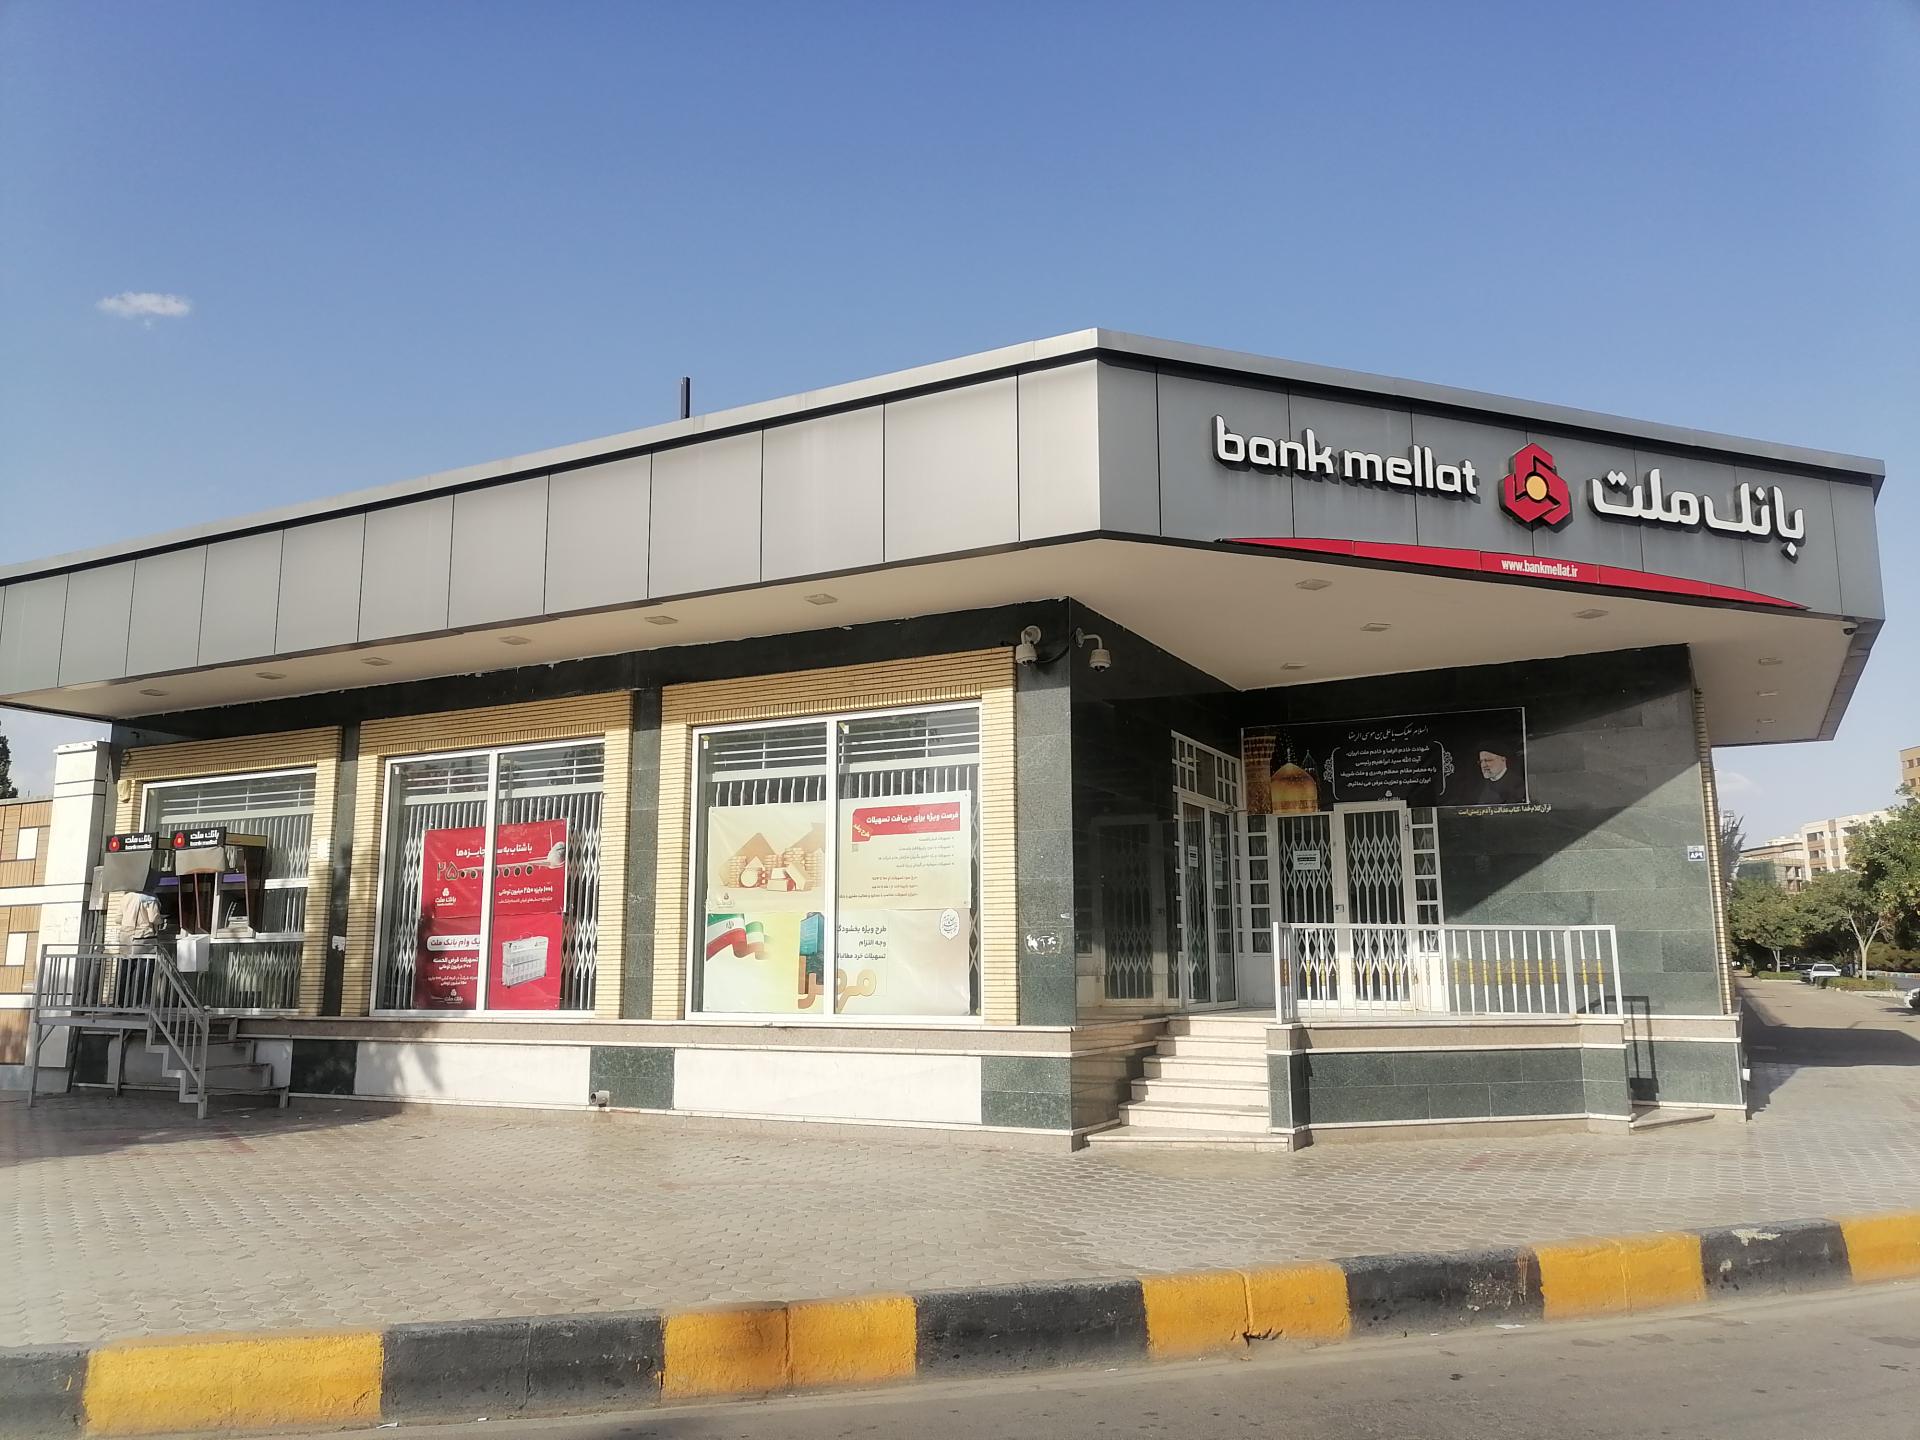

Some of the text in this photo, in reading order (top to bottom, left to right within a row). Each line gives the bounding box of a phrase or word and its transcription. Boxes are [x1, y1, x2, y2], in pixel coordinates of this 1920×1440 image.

[1214, 415, 1478, 495] bank mellat
[1590, 468, 1805, 558] بانک ملت
[1501, 559, 1579, 578] www.bankmellat.ir
[866, 815, 891, 826] تسهیلات
[890, 813, 912, 824] دریافت
[912, 813, 926, 823] برای
[926, 812, 941, 823] ویژه
[861, 924, 875, 934] ویژه
[875, 925, 887, 935] طرح
[858, 939, 887, 948] وجه التزام
[863, 952, 887, 961] تسهیلات
